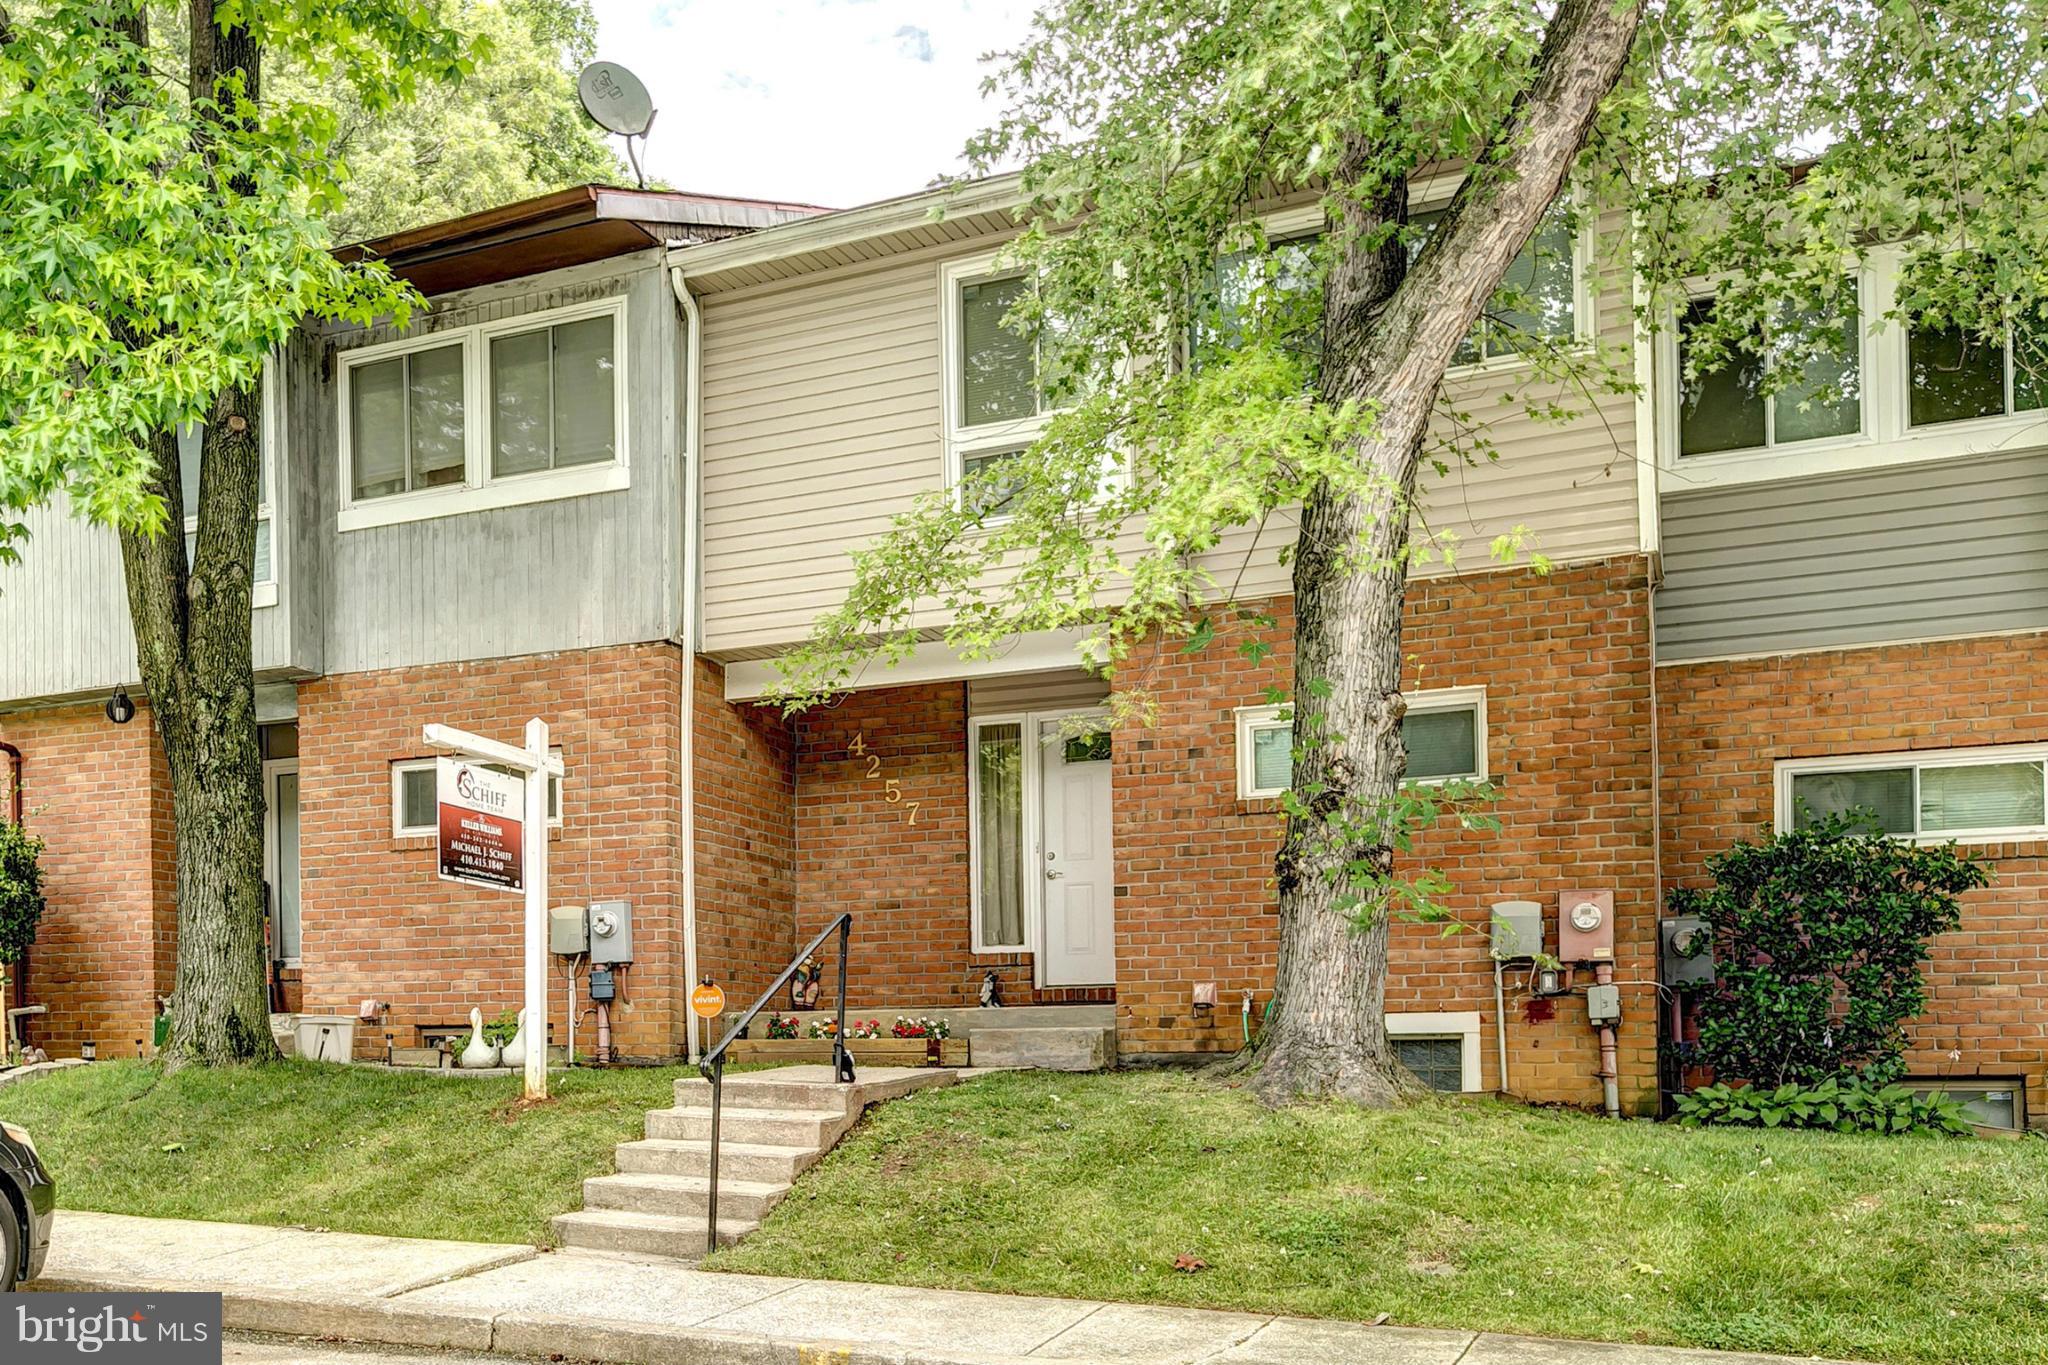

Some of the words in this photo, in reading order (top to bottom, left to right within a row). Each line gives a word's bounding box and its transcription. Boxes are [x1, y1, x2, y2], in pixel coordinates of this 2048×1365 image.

[457, 771, 507, 808] SCHIFF
[451, 840, 482, 856] MICHAEL
[489, 847, 512, 861] SCHIFF
[461, 854, 504, 871] 410.415.1840
